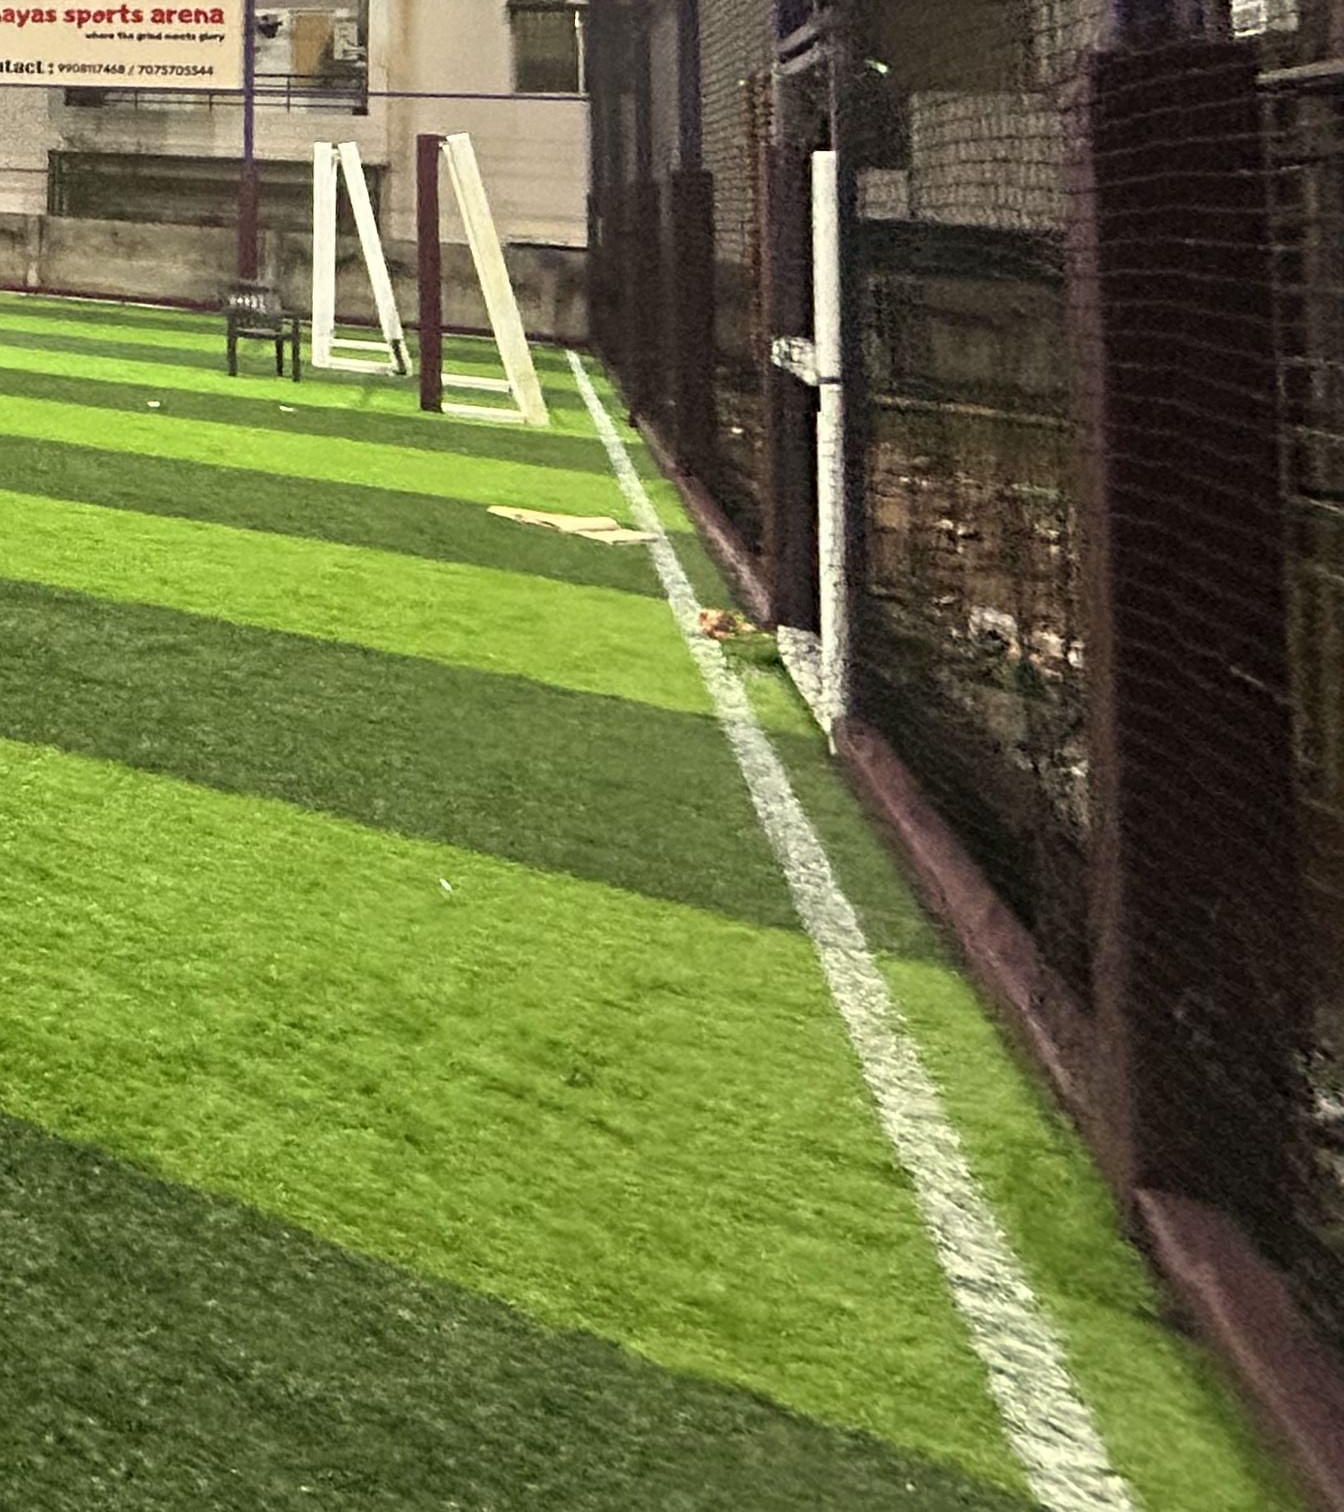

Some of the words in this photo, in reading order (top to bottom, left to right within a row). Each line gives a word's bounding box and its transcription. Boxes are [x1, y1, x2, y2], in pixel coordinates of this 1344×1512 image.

[63, 4, 144, 28] sports
[150, 7, 224, 25] arena
[85, 32, 115, 40] where
[117, 32, 134, 40] the
[199, 33, 225, 43] glory
